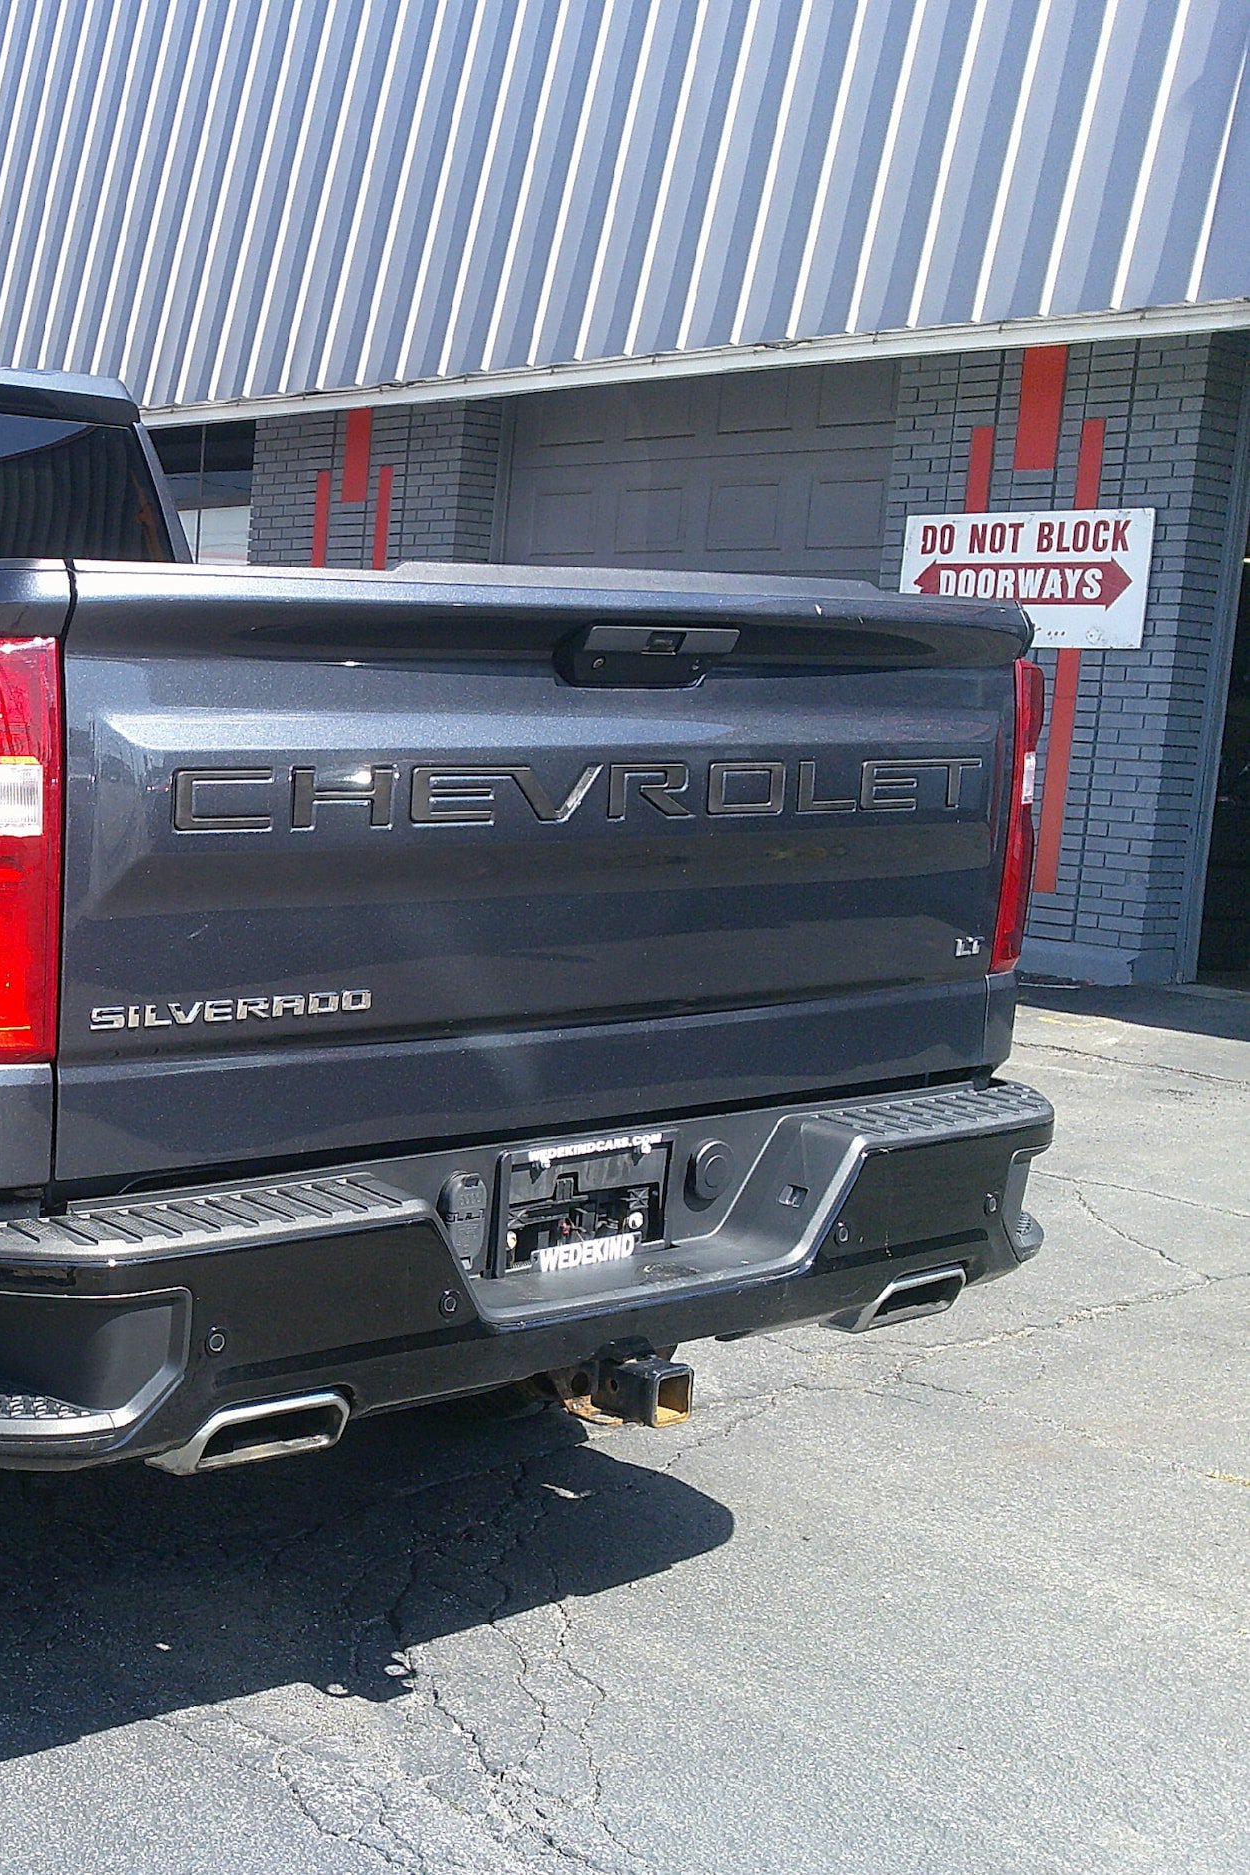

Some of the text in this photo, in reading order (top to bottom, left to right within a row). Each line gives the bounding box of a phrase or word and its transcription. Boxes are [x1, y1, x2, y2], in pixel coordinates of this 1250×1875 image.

[920, 519, 1132, 555] DO NOT BLOCK
[939, 567, 1103, 599] DOORWAYS
[170, 755, 984, 834] CHEVROLET
[955, 935, 985, 957] LT
[89, 989, 372, 1031] SILVERADO
[528, 1132, 663, 1162] WEDEKINDCARS.COM
[539, 1233, 636, 1272] WEDEKIND
